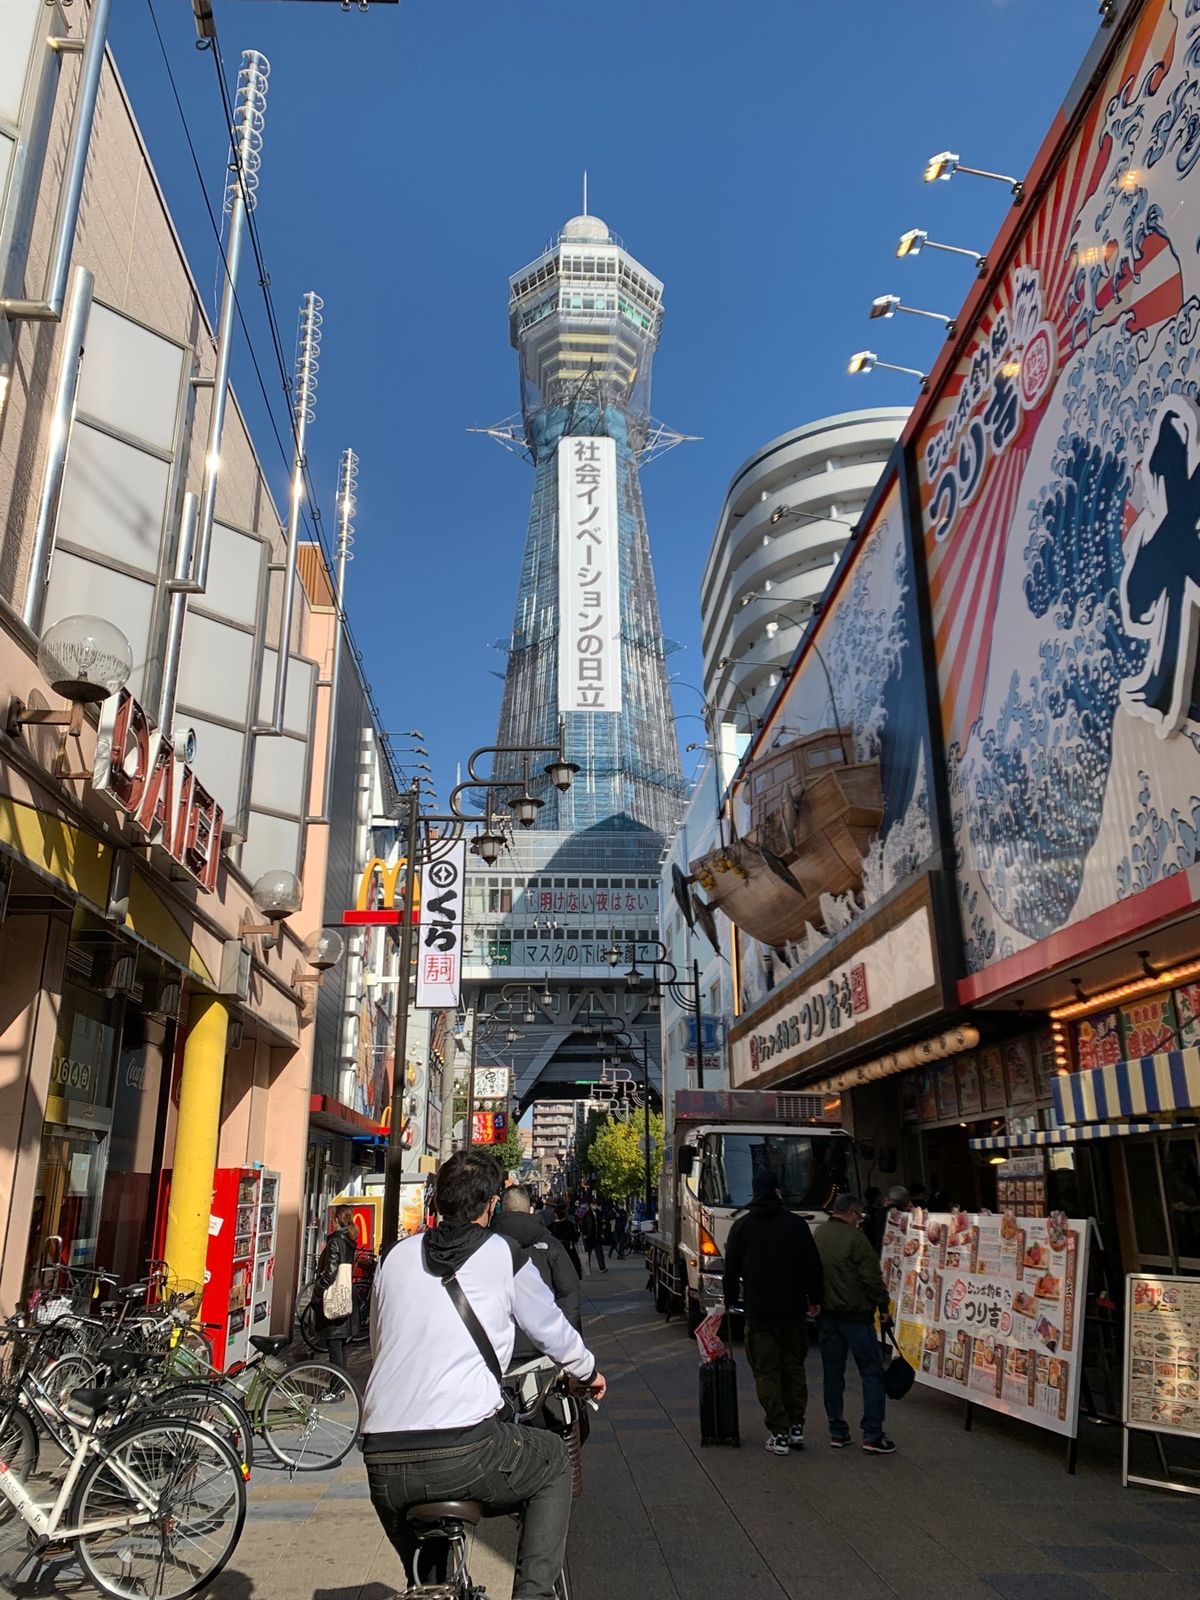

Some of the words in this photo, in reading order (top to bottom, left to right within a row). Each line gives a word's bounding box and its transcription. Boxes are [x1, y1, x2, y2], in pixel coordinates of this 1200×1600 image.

[573, 440, 606, 708] 社会イノベーションの日立
[424, 889, 458, 952] くら
[425, 955, 454, 983] 寿司
[965, 1301, 1002, 1329] つり吉
[1149, 1300, 1182, 1313] メニュー
